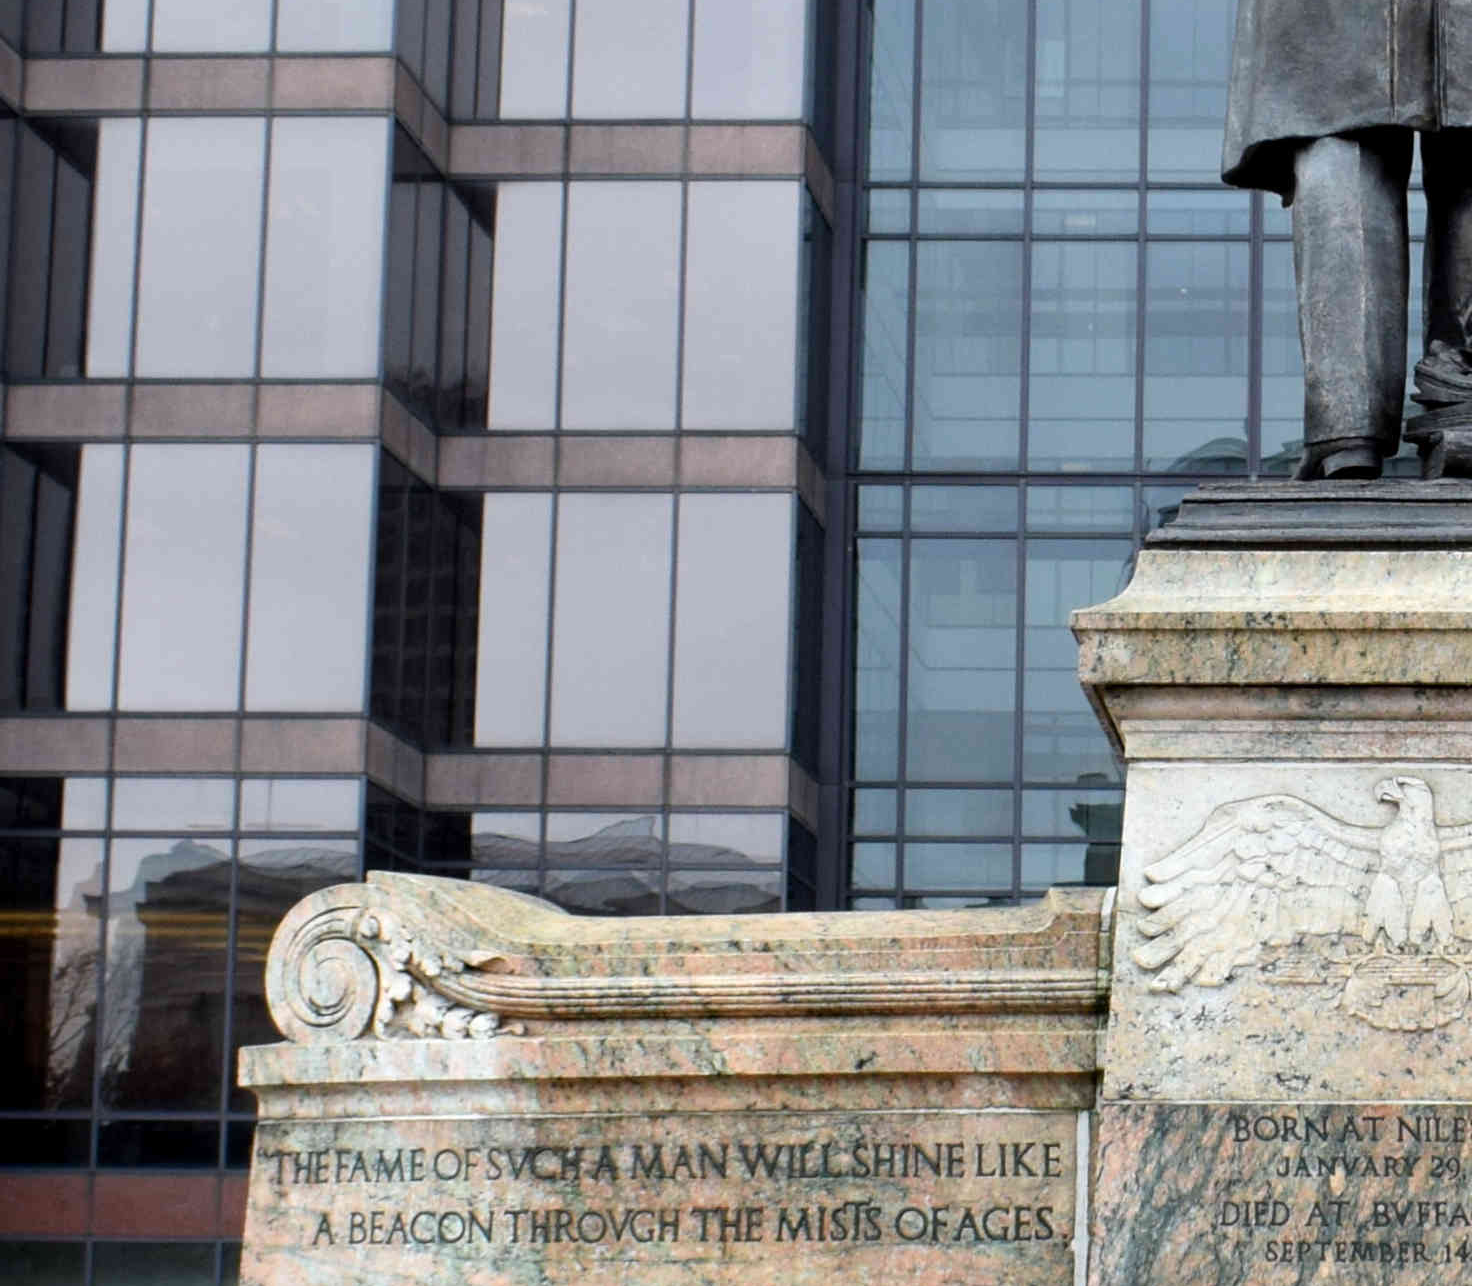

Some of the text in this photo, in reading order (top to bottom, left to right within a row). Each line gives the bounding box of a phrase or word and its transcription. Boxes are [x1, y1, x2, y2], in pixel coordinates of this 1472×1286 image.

[1232, 1116, 1329, 1142] BORN
[1341, 1116, 1385, 1141] AT
[335, 1147, 425, 1182] FAME
[433, 1148, 479, 1181] OF
[486, 1146, 583, 1181] SVCH
[593, 1144, 618, 1180] A
[631, 1143, 729, 1180] MAN
[738, 1141, 848, 1179] WILL
[852, 1142, 964, 1179] SHINE
[975, 1142, 1062, 1178] LIKE
[1276, 1156, 1421, 1178] JANVARY
[312, 1213, 334, 1245] A
[348, 1211, 494, 1244] BEACON
[504, 1209, 678, 1243] THROVGH
[690, 1206, 763, 1243] THE
[776, 1200, 881, 1242] MISTS
[895, 1207, 949, 1242] OF
[1220, 1201, 1290, 1227] DIED
[1305, 1201, 1350, 1227] AT
[1265, 1241, 1431, 1265] SEPTEMBER
